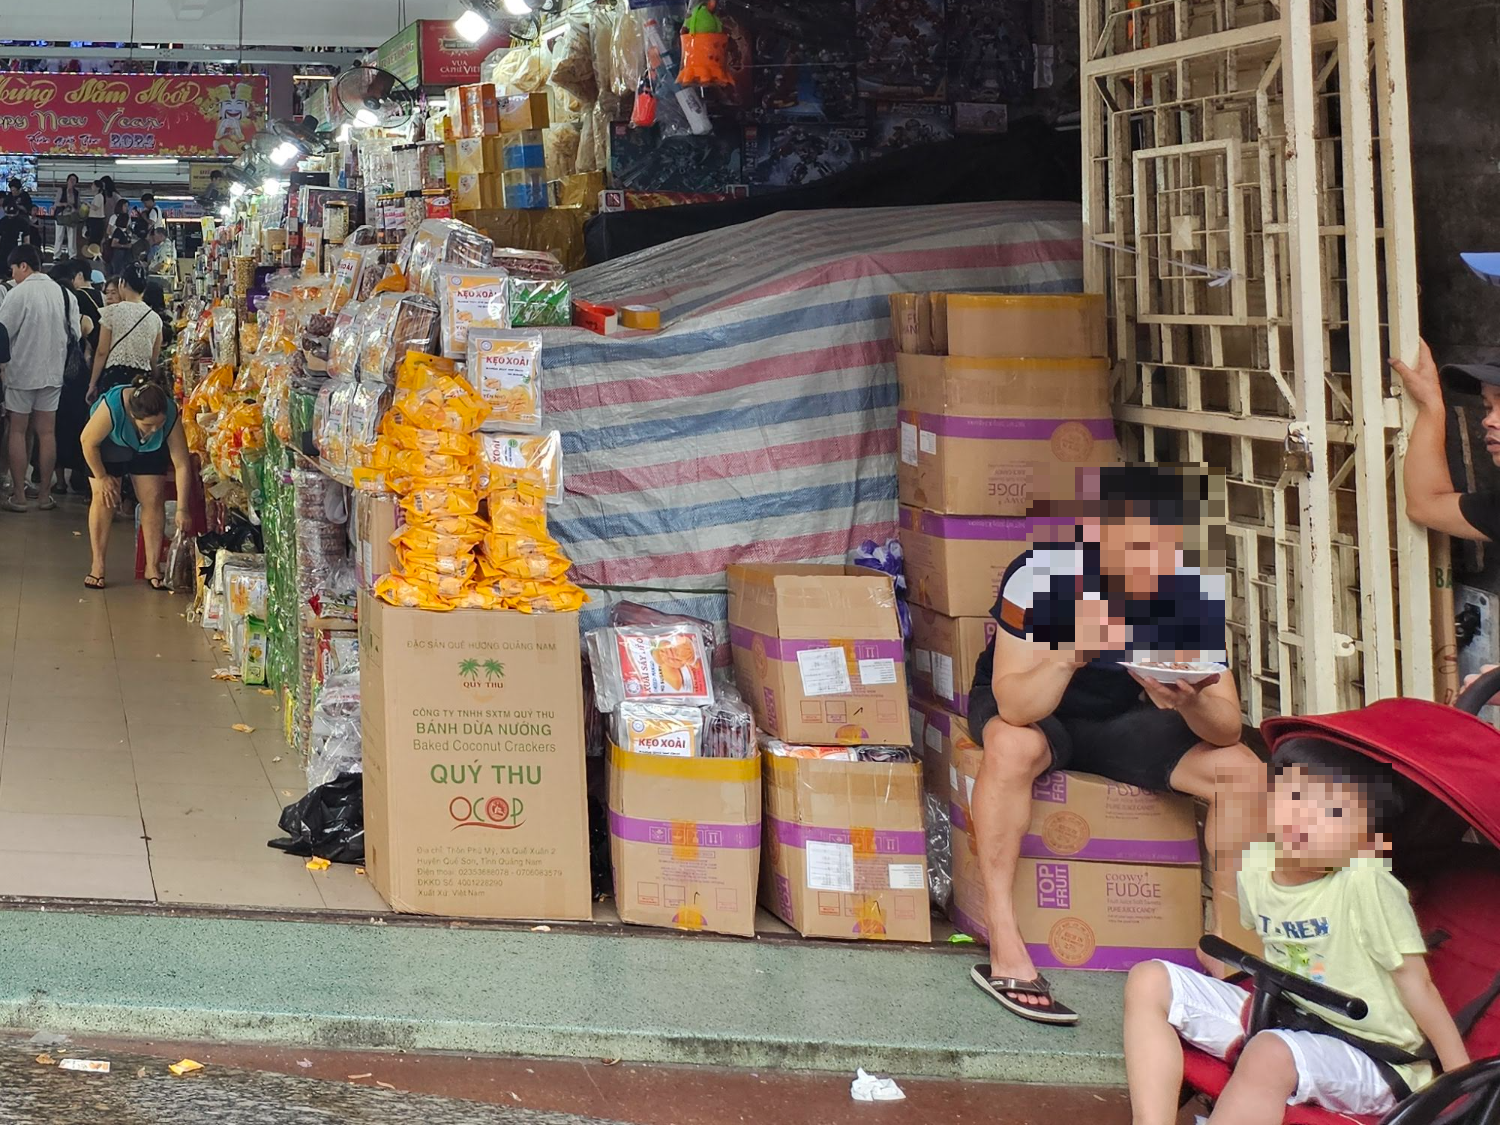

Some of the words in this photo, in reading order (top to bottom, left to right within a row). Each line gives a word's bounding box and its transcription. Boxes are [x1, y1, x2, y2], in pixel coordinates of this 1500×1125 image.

[64, 76, 131, 104] Năm
[134, 76, 200, 106] Mới
[30, 110, 88, 131] New
[97, 106, 164, 133] Year
[486, 356, 505, 368] KẸO
[505, 355, 529, 366] XOÀI
[536, 642, 556, 651] NAM
[412, 707, 440, 717] CÔNG
[443, 709, 454, 717] TY
[458, 709, 482, 718] TNHH
[485, 710, 511, 718] SXTM
[536, 710, 555, 719] THU
[416, 719, 458, 734] BÁNH
[463, 719, 493, 735] DỪA
[498, 720, 552, 736] NƯỚNG
[413, 738, 449, 751] Baked
[453, 739, 501, 752] Coconut
[504, 740, 556, 753] Crackers
[638, 737, 659, 749] KẸO
[661, 736, 686, 749] XOÀI
[430, 759, 482, 784] QUÝ
[491, 765, 542, 785] THU
[450, 796, 524, 825] OCOP
[468, 889, 485, 897] Nam
[1040, 865, 1055, 906] TOP
[1056, 865, 1069, 907] FRUIT
[1106, 882, 1161, 898] FUDGE
